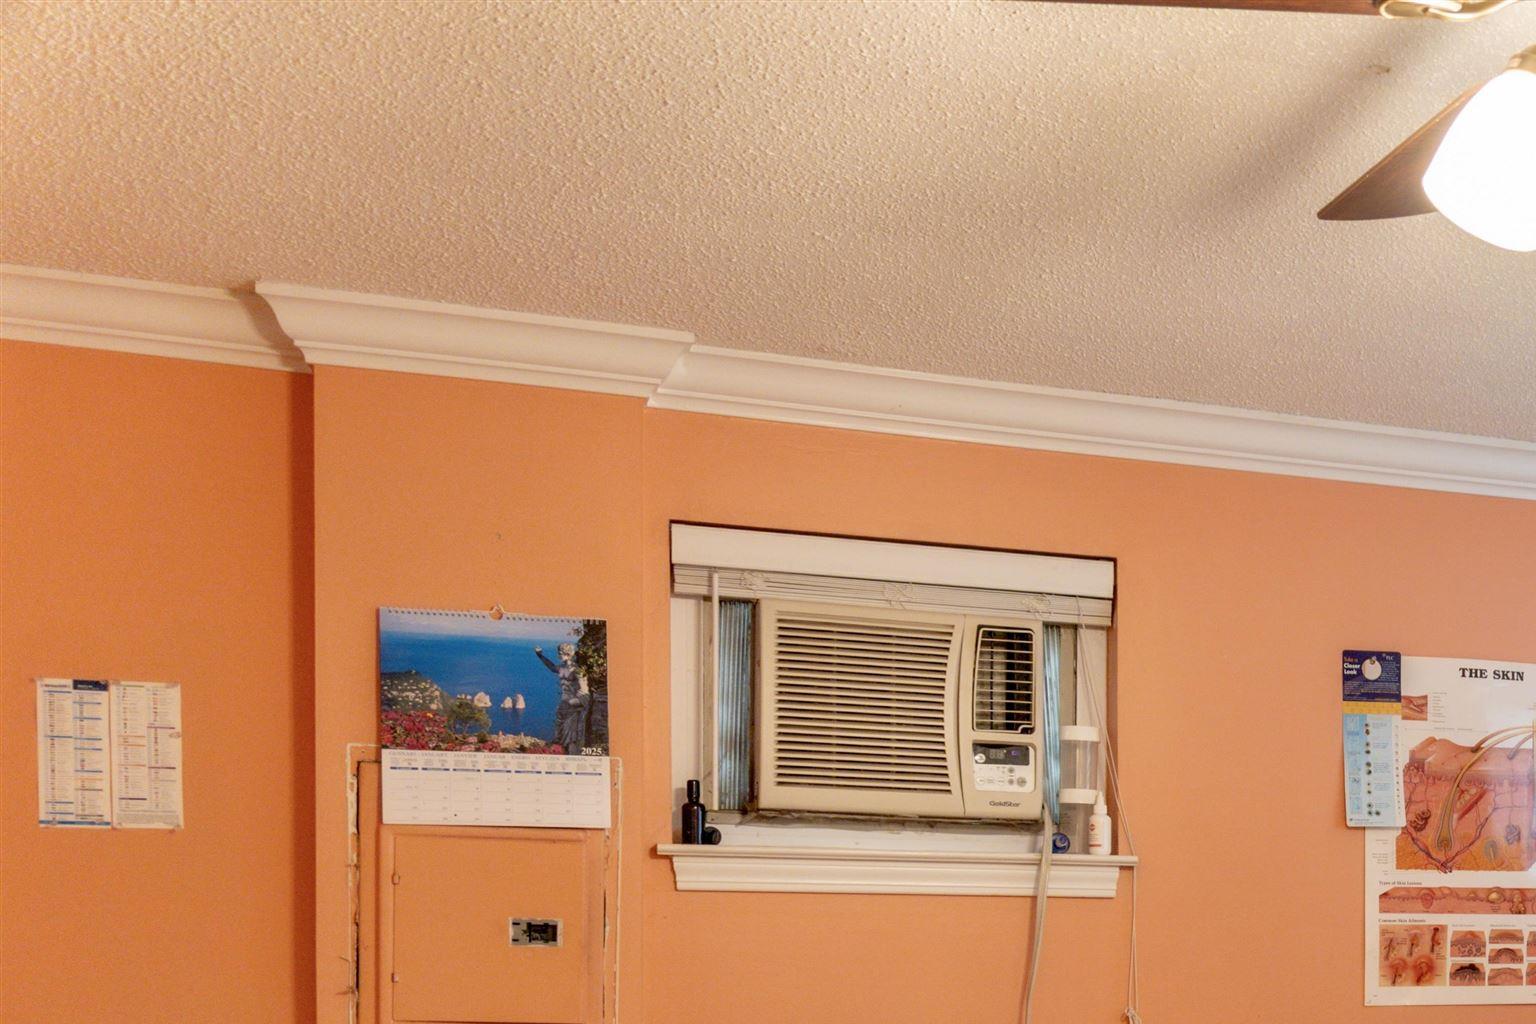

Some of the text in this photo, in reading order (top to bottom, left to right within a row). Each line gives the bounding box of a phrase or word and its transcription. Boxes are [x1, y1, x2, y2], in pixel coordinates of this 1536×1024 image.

[1458, 667, 1525, 682] THE SKIN
[581, 746, 603, 756] 2025
[989, 800, 1021, 808] GoldStar
